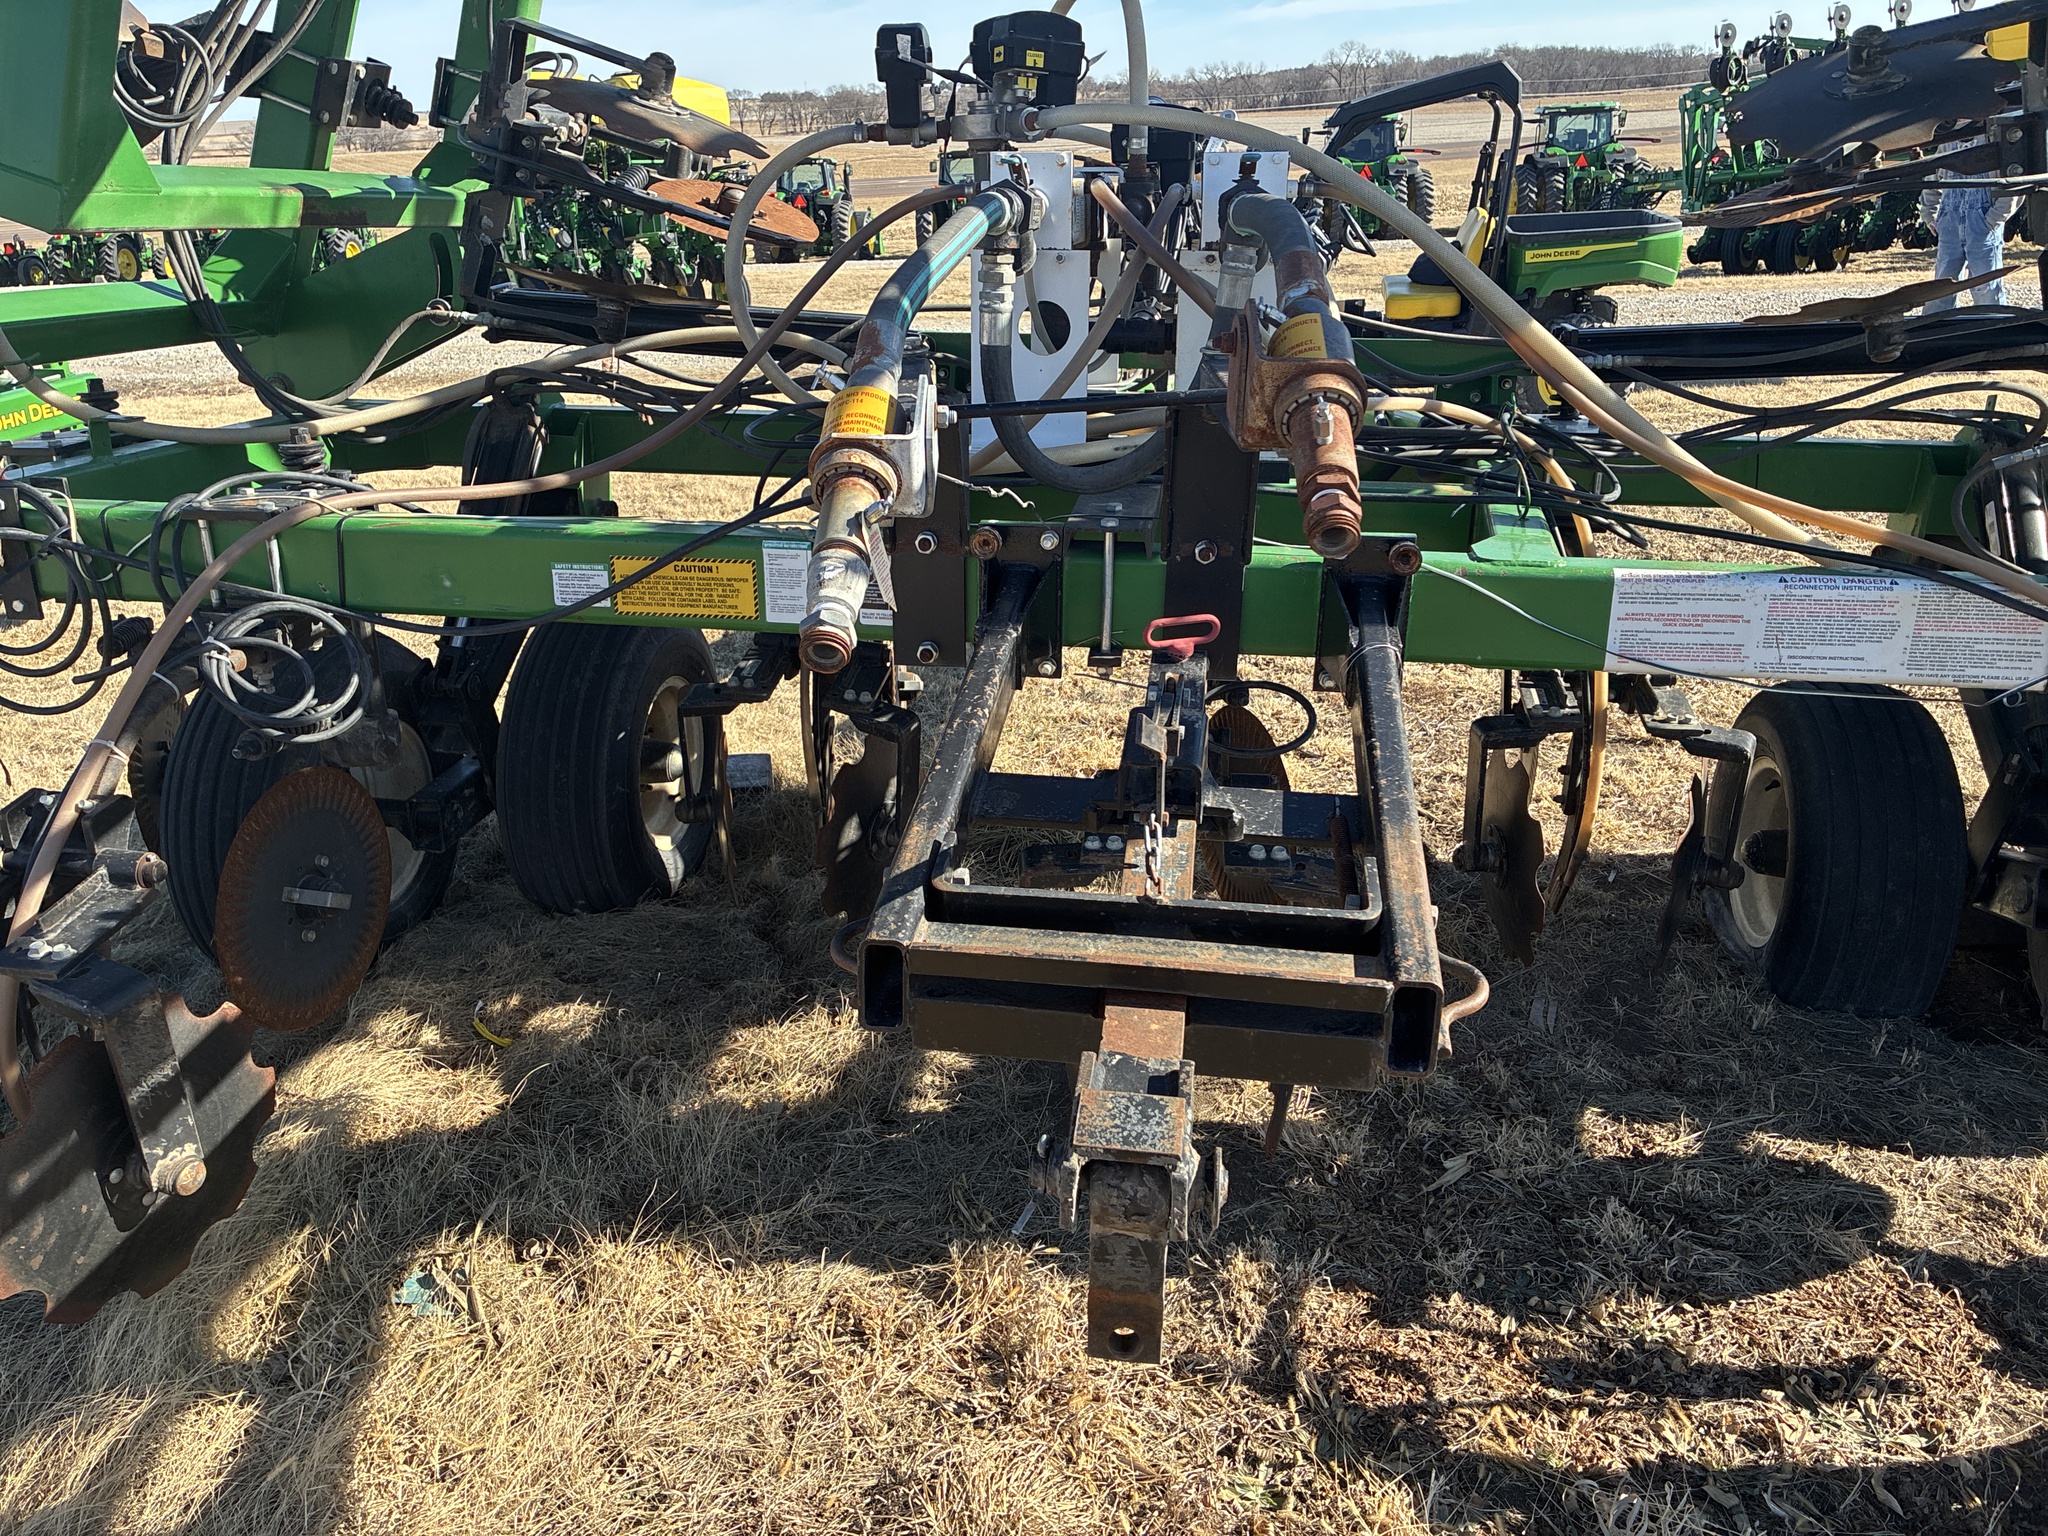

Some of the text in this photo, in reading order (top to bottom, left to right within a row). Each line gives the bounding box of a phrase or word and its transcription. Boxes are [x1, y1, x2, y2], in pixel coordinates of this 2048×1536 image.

[1283, 318, 1318, 334] PRODUCTS
[845, 412, 884, 424] RECONNECT
[674, 564, 713, 573] CAUTION
